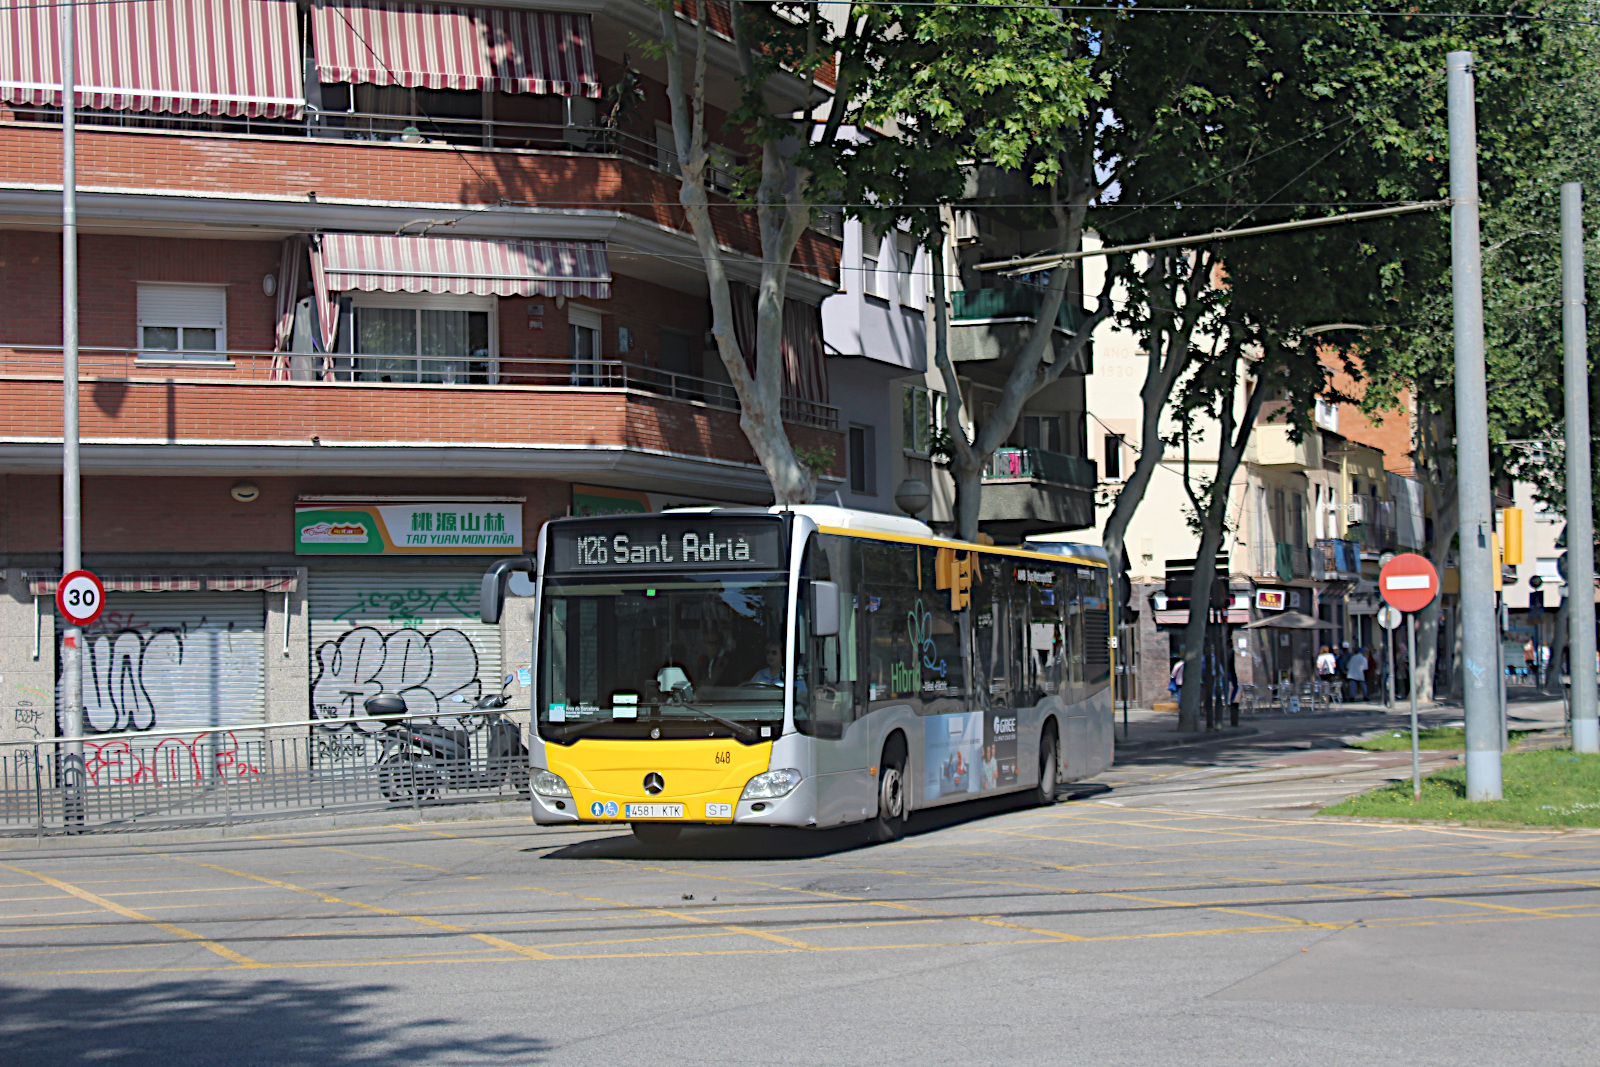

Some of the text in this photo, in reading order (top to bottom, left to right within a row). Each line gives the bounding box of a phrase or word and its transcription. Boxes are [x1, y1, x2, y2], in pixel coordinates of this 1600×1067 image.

[1101, 366, 1133, 377] 1930
[411, 512, 505, 531] 桃源山林
[406, 533, 514, 544] TAO YUAN MONTAÑA
[577, 532, 750, 564] M26 Sant Adrià
[69, 590, 95, 606] 30
[1000, 718, 1016, 733] GREE
[715, 751, 731, 764] 648
[631, 805, 681, 816] 4581 KTK
